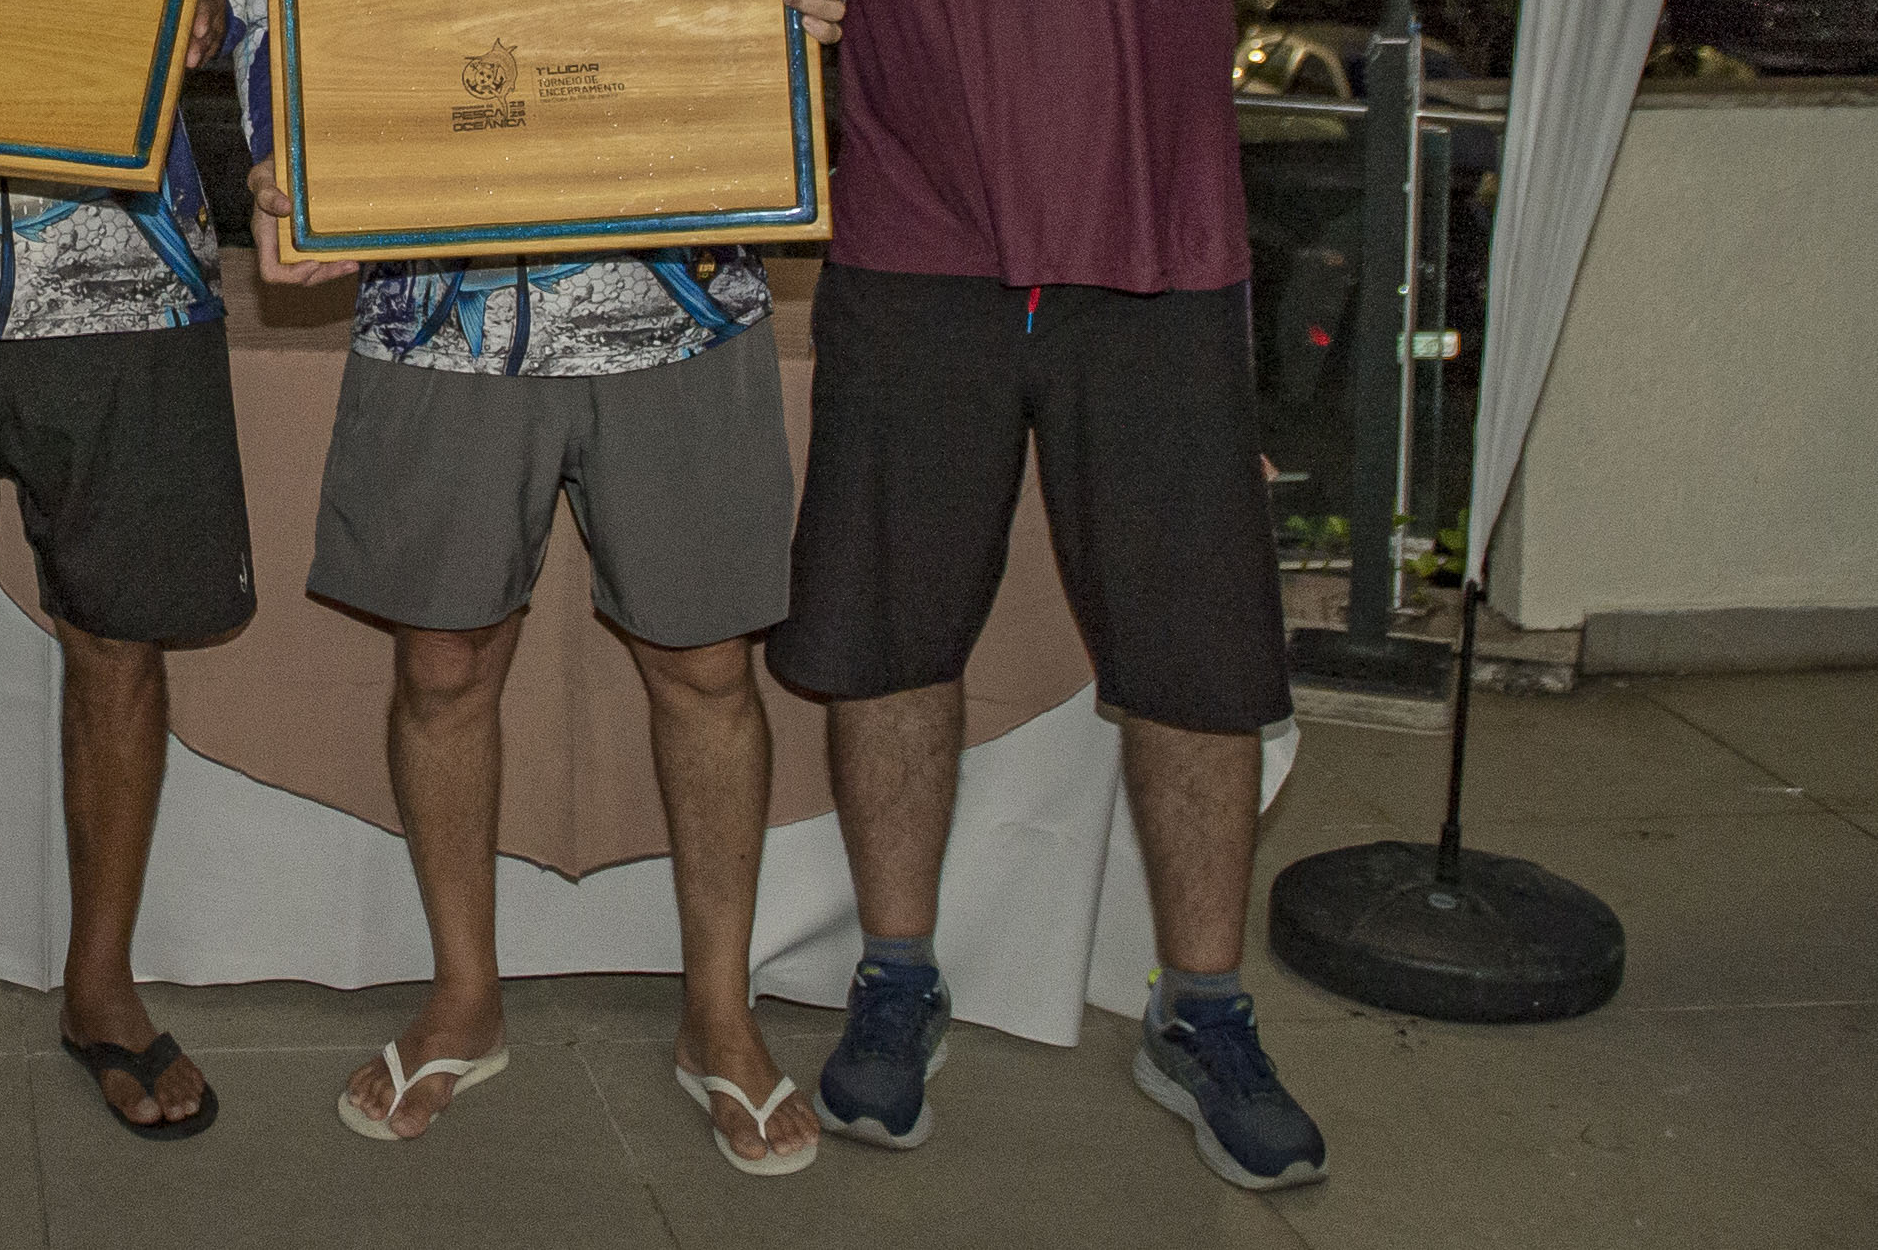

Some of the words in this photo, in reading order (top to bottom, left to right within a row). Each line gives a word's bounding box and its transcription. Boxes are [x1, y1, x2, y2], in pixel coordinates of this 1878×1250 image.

[546, 63, 600, 75] LUGAR
[538, 76, 582, 88] TORNEIO
[584, 75, 598, 85] DE
[538, 82, 626, 98] ENCERRAMENTO
[452, 109, 504, 120] PESCA
